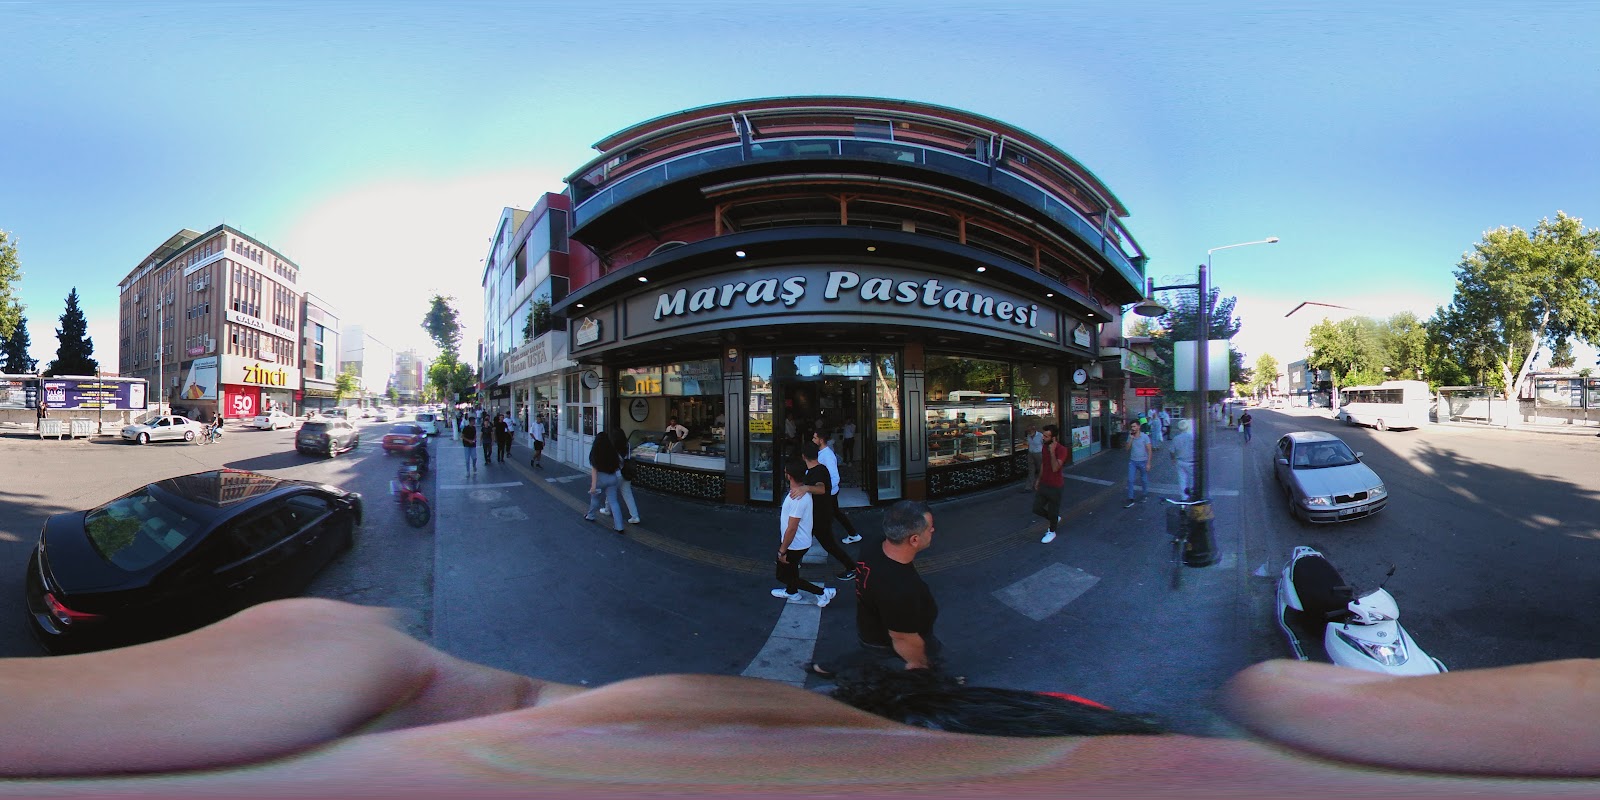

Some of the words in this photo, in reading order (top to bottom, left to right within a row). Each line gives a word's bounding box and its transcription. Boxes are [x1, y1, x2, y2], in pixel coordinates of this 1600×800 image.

[653, 276, 808, 321] Maraş
[824, 270, 1038, 328] Pastanesi
[243, 363, 288, 386] zincir
